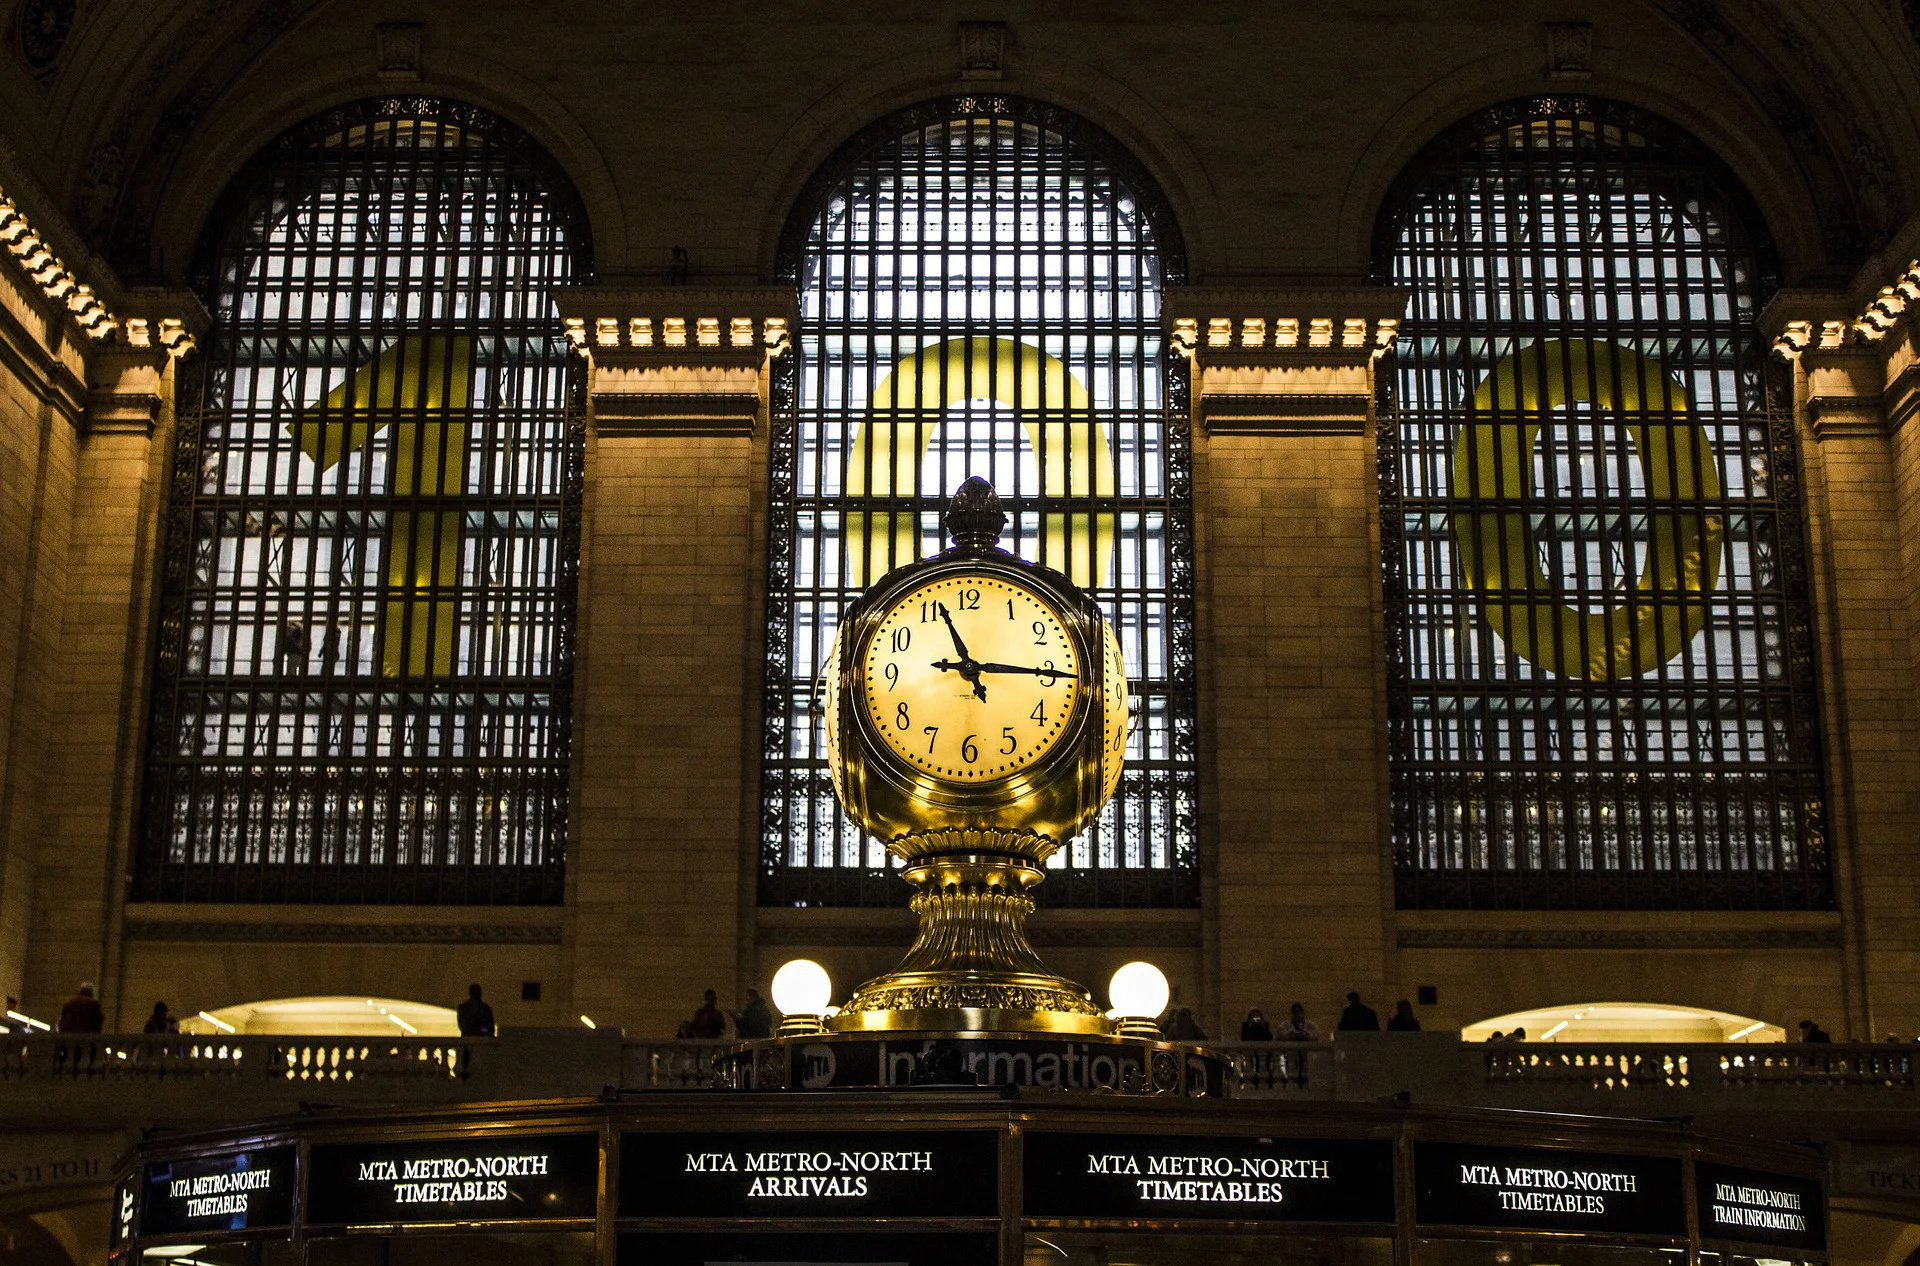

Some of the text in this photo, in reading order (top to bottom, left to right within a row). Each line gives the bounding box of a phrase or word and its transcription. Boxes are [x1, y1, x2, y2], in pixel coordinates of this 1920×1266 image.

[920, 600, 938, 623] 11
[958, 589, 981, 611] 12
[1006, 599, 1015, 621] 1
[891, 627, 911, 653] 10
[1033, 622, 1048, 645] 2
[885, 663, 898, 692] 9
[1039, 661, 1057, 687] 3
[1116, 683, 1122, 711] 9
[896, 702, 910, 731] 8
[1030, 700, 1048, 727] 4
[924, 726, 939, 754] 7
[962, 734, 979, 763] 6
[1000, 727, 1017, 755] 5
[1113, 725, 1122, 751] 8
[879, 1040, 1142, 1088] Inrmation
[358, 1156, 549, 1181] MTA METRO-NORTH
[685, 1152, 933, 1172] MTA METRO-NORTH
[1087, 1155, 1330, 1179] MTA METRO-NORTH
[170, 1169, 270, 1197] MTA METRO-NORTH
[394, 1181, 507, 1203] TIMETABLES
[748, 1177, 867, 1197] ARRIVALS
[1137, 1180, 1283, 1203] TIMETABLES
[1461, 1165, 1637, 1193] MTA METRO-NORTH
[187, 1193, 248, 1218] TIMETABLES
[1499, 1191, 1605, 1214] TIMETABLES
[1716, 1183, 1801, 1210] MTA METRO-NORTH
[1713, 1205, 1805, 1232] TRAIN INFORMATION
